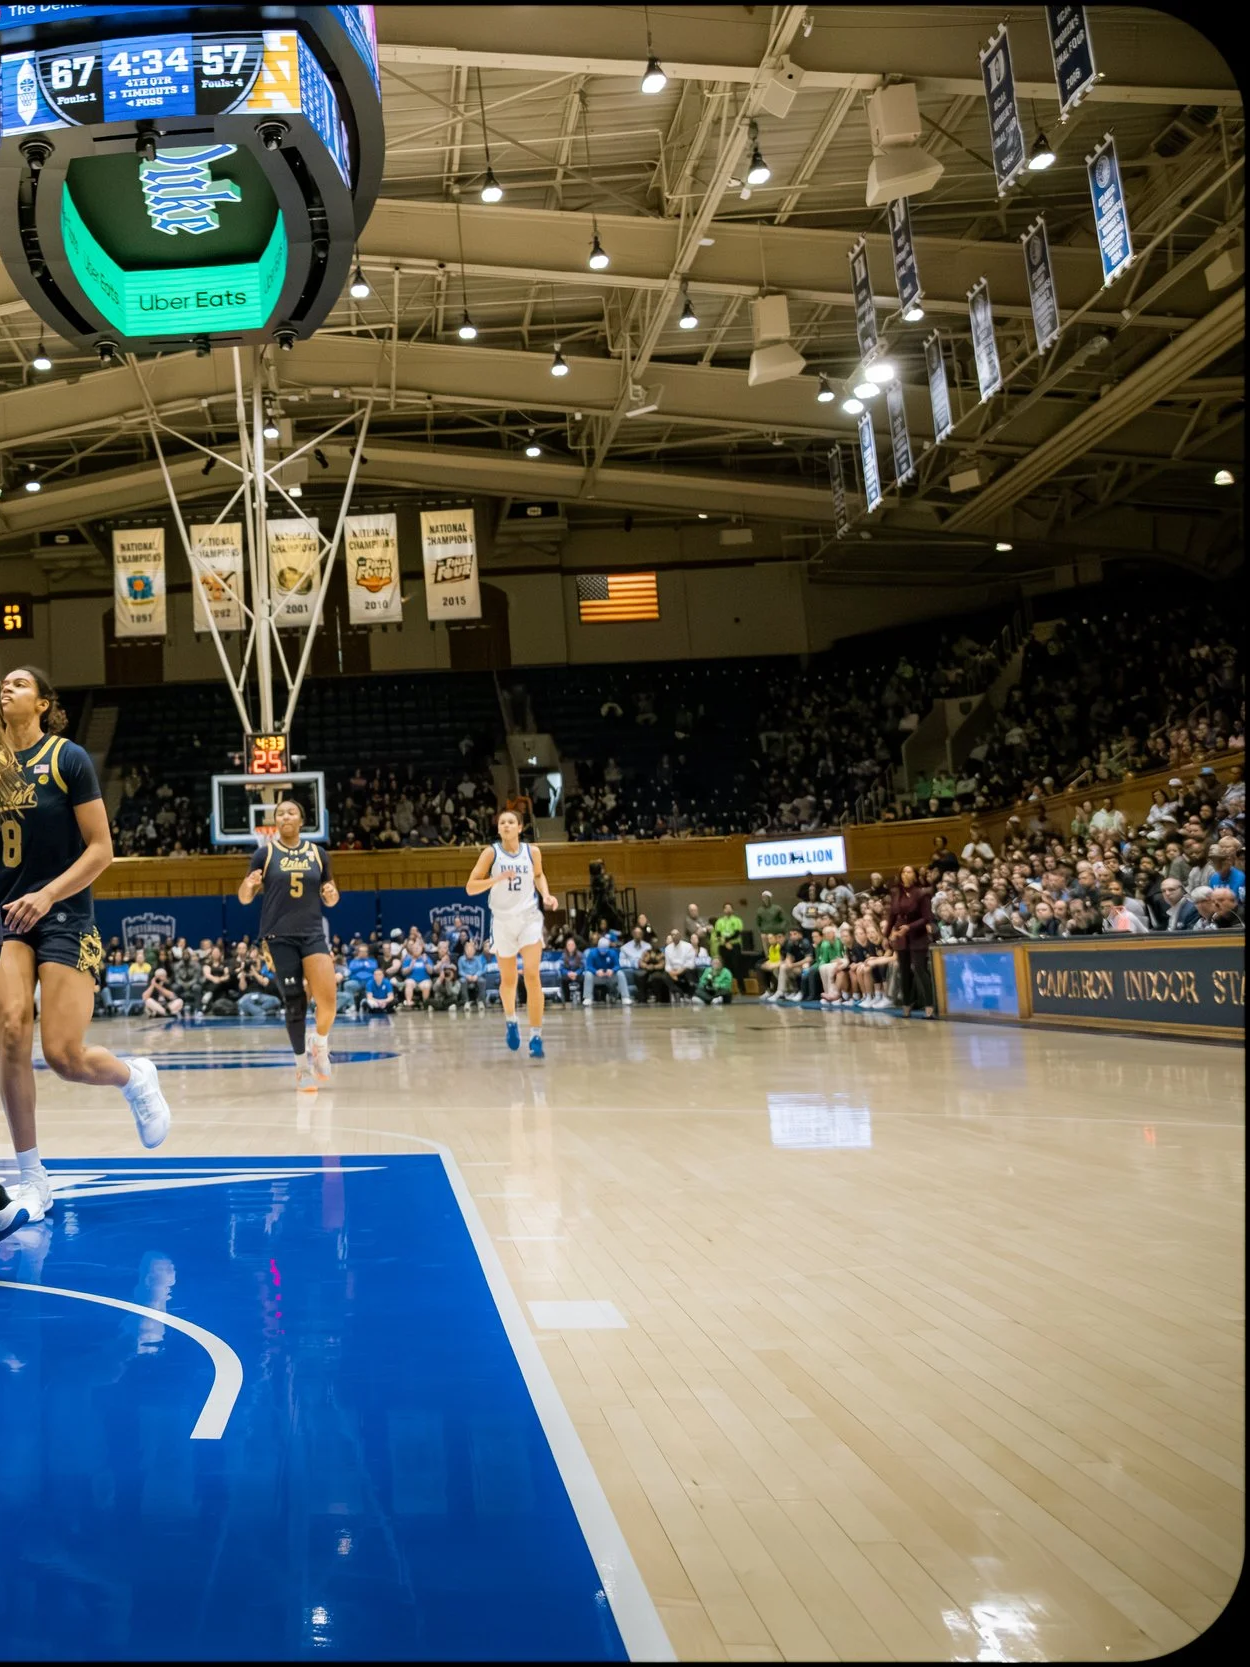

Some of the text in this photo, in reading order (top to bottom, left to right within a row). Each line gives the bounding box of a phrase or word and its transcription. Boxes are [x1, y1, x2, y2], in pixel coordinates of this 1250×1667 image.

[7, 5, 36, 17] The
[107, 47, 189, 77] 4:34
[201, 44, 247, 76] 57
[51, 55, 96, 90] 67
[125, 75, 173, 88] 4TH QTR
[201, 78, 244, 89] Fouls: 4
[57, 92, 97, 106] Fouls: 1
[108, 84, 190, 100] 3 TIMEOUTS 2
[135, 96, 164, 107] POSS
[139, 290, 247, 312] Uber Eats
[351, 527, 390, 538] NATIONAL
[428, 521, 468, 534] NATIONAL
[120, 541, 158, 553] NATIONAL
[348, 538, 395, 551] CHAMPIONS
[427, 534, 474, 547] CHAMPIONS
[116, 552, 162, 565] CHAMPIONS
[199, 548, 241, 558] HAMPIONS
[434, 562, 472, 584] FOUR
[364, 600, 390, 611] 2010
[441, 596, 467, 607] 2015
[285, 604, 309, 615] 2001
[2, 614, 22, 631] 57
[255, 735, 286, 751] 4:33
[252, 749, 283, 773] 25
[1, 819, 22, 869] 8
[757, 848, 834, 867] FOOD LION
[289, 871, 304, 898] 5
[507, 875, 522, 892] 12
[1036, 968, 1115, 1000] CAMERON
[1123, 970, 1200, 1004] INDOOR
